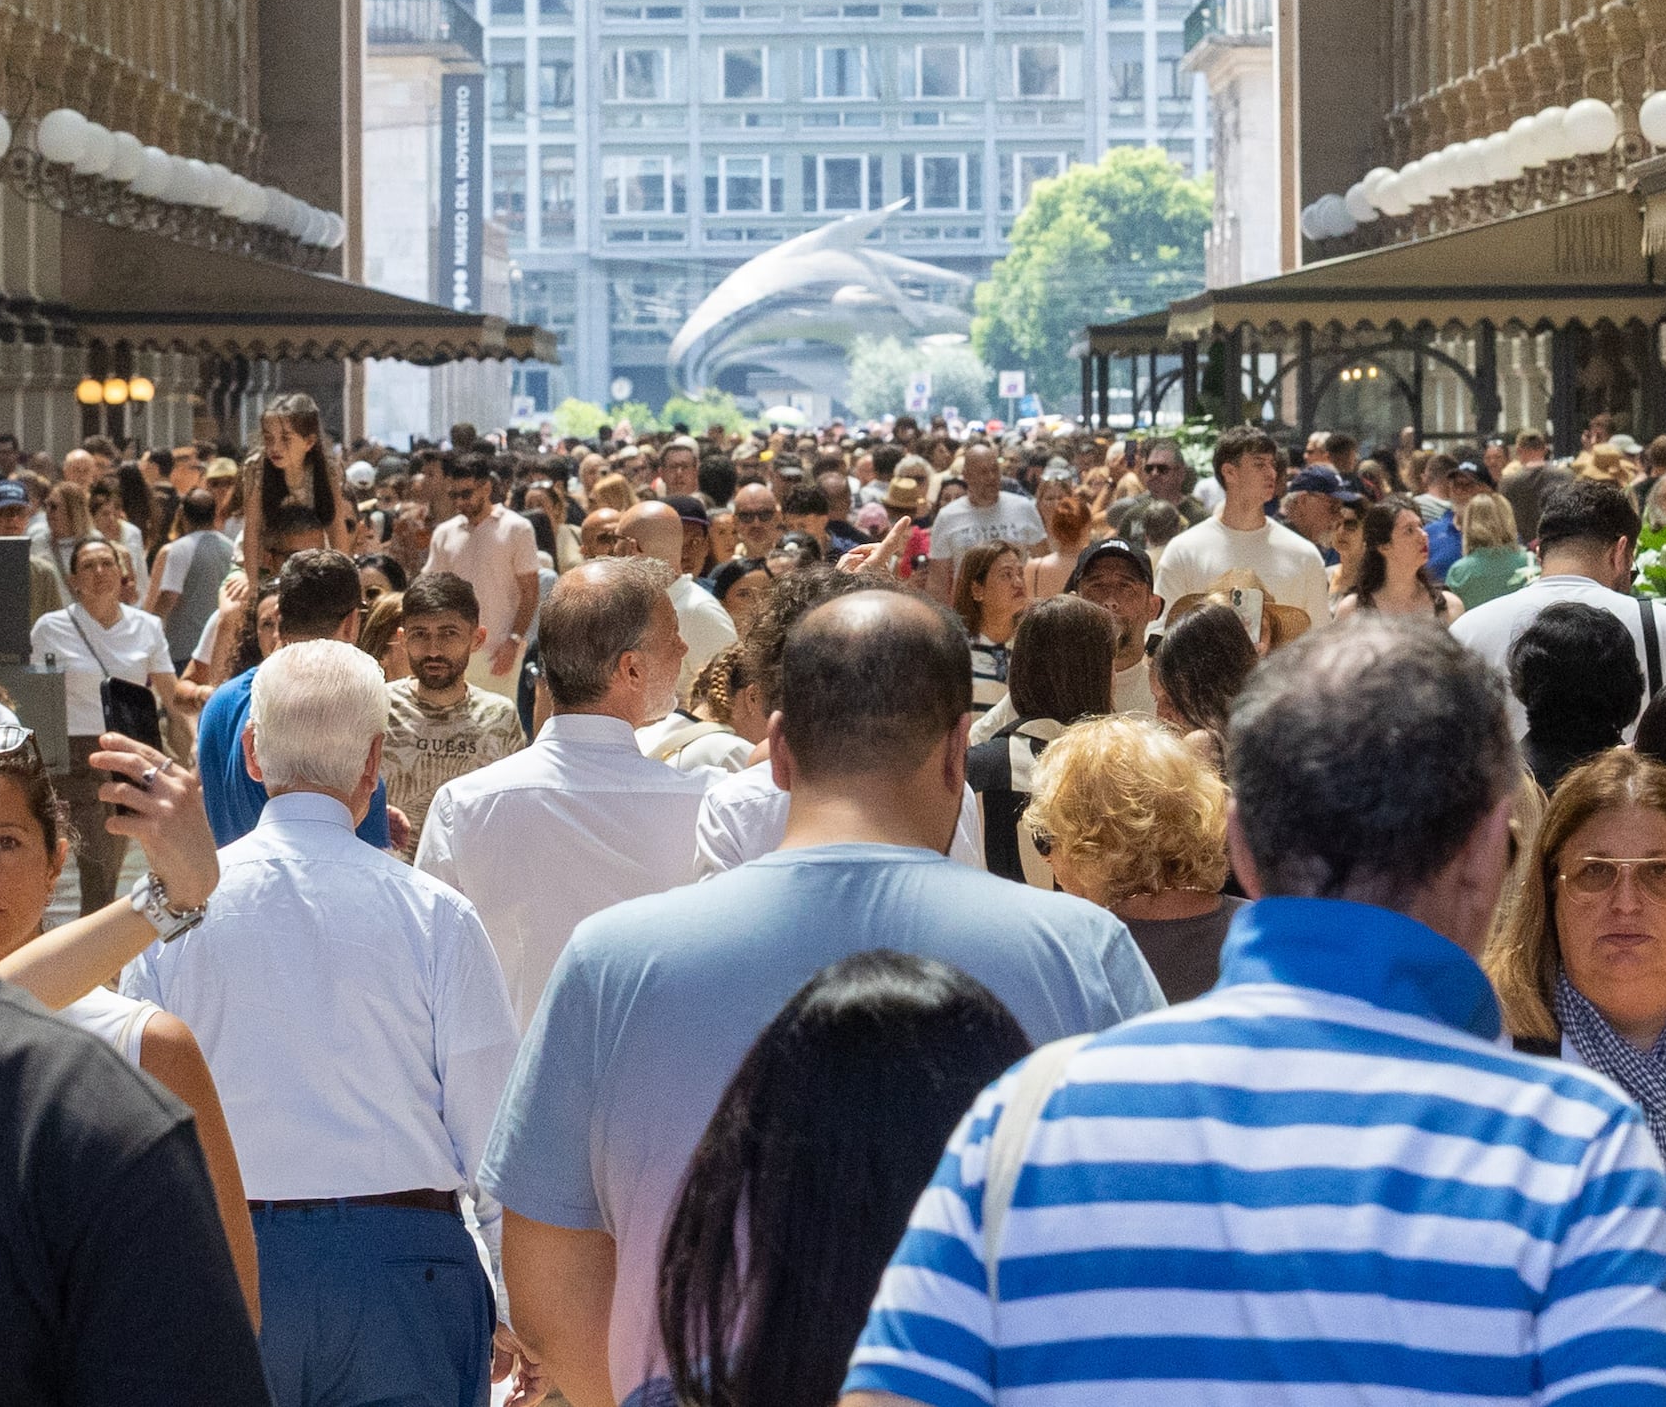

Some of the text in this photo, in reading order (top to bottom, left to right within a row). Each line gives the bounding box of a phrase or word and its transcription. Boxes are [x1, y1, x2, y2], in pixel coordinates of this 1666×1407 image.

[455, 85, 470, 179] NOVECENTO
[455, 180, 469, 210] DEL
[454, 211, 469, 266] MUSEO
[416, 738, 477, 754] GUESS
